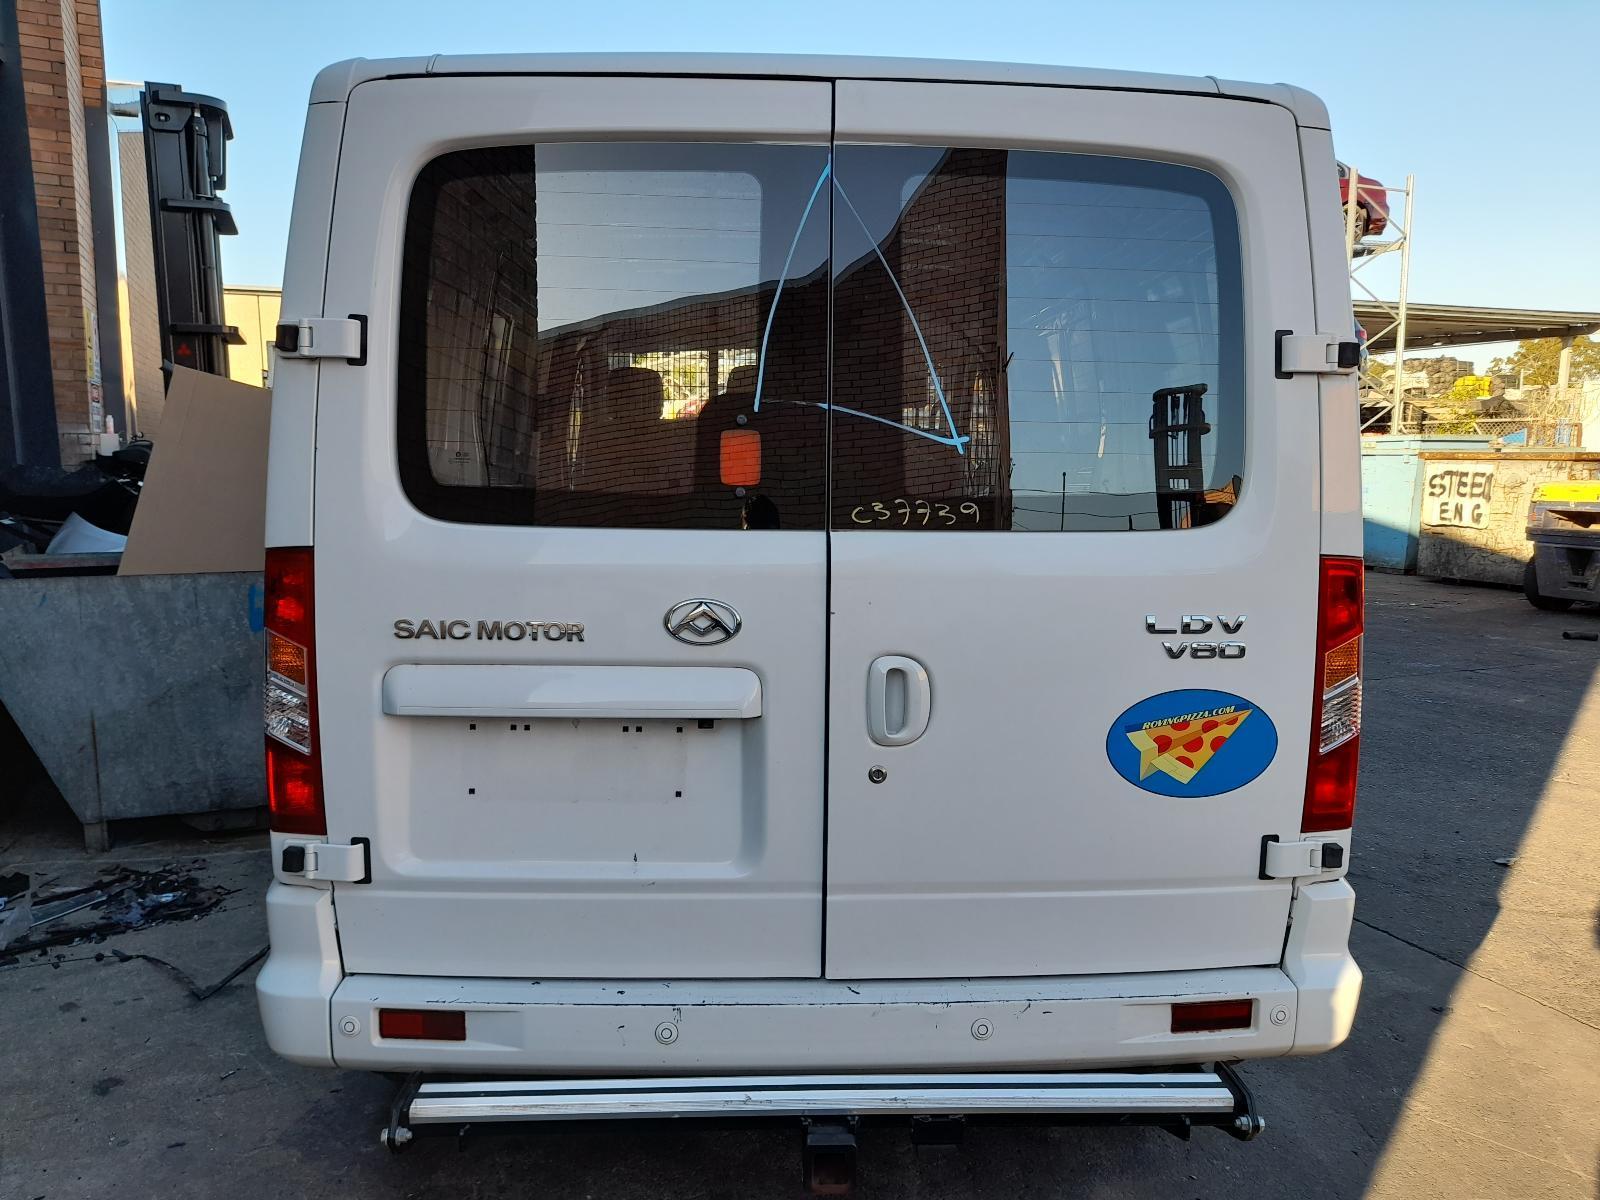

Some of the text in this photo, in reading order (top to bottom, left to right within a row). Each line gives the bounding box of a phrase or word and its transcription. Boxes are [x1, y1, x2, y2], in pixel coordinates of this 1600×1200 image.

[851, 499, 980, 525] C37739
[394, 619, 585, 642] SAIC MOTOR
[1146, 615, 1247, 634] LDV
[1162, 641, 1246, 659] V80
